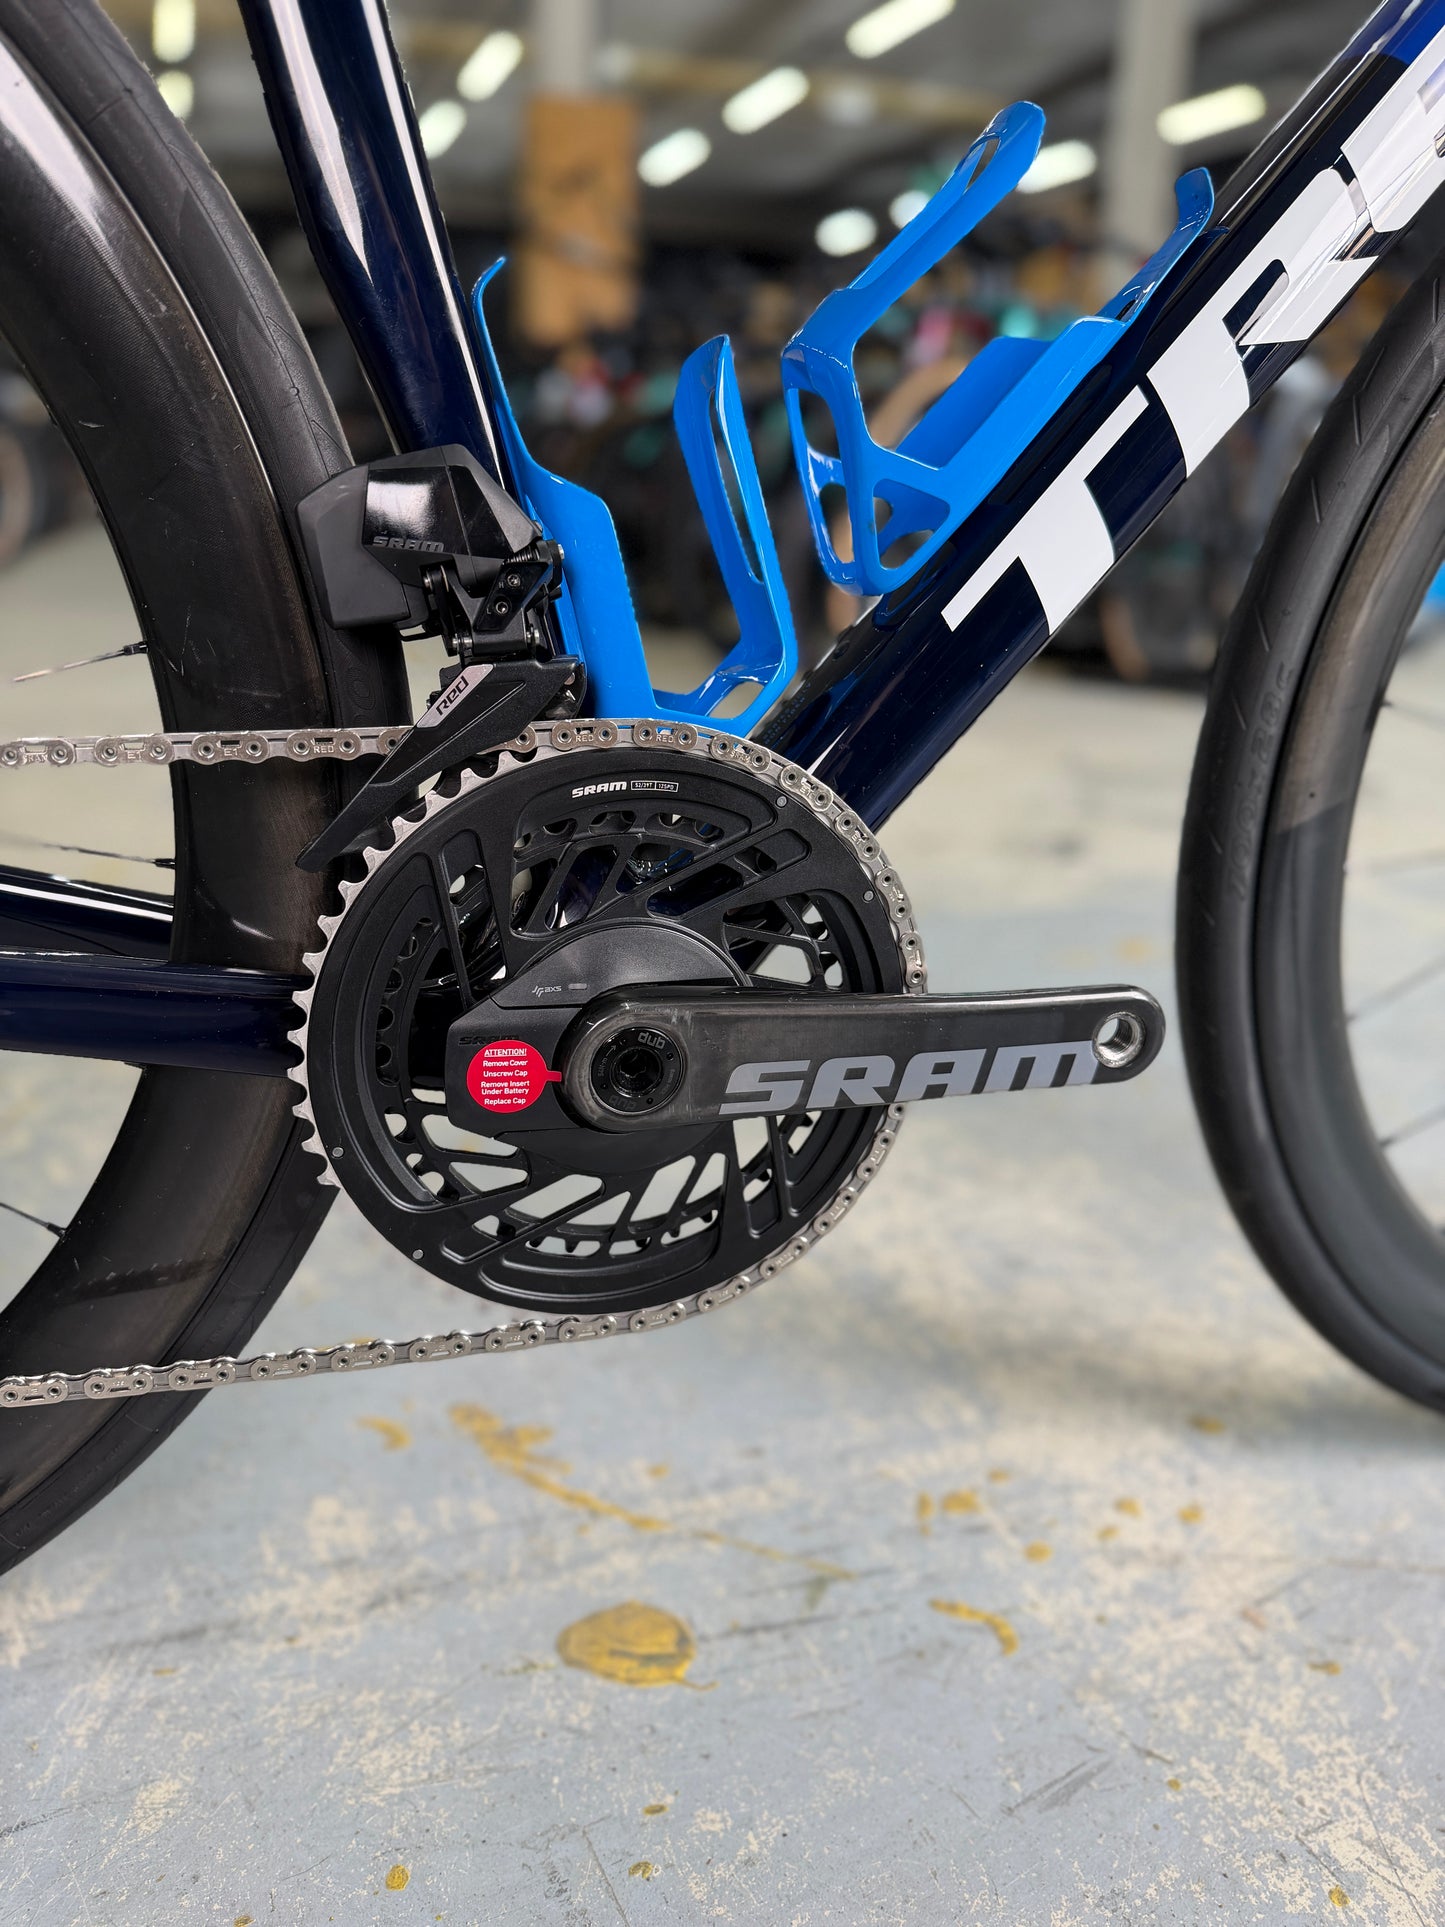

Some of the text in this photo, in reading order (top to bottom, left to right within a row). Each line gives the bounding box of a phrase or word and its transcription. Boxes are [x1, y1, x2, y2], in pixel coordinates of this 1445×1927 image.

[372, 536, 444, 552] SRAM
[574, 734, 595, 742] RED
[655, 734, 674, 743] RED
[313, 745, 335, 754] RED
[572, 781, 628, 798] SRAM
[637, 1032, 666, 1050] dub
[484, 1048, 527, 1058] ATTENTION!
[514, 1070, 528, 1078] Cap
[718, 1040, 1100, 1115] SRAM
[484, 1098, 526, 1106] Replace Cap
